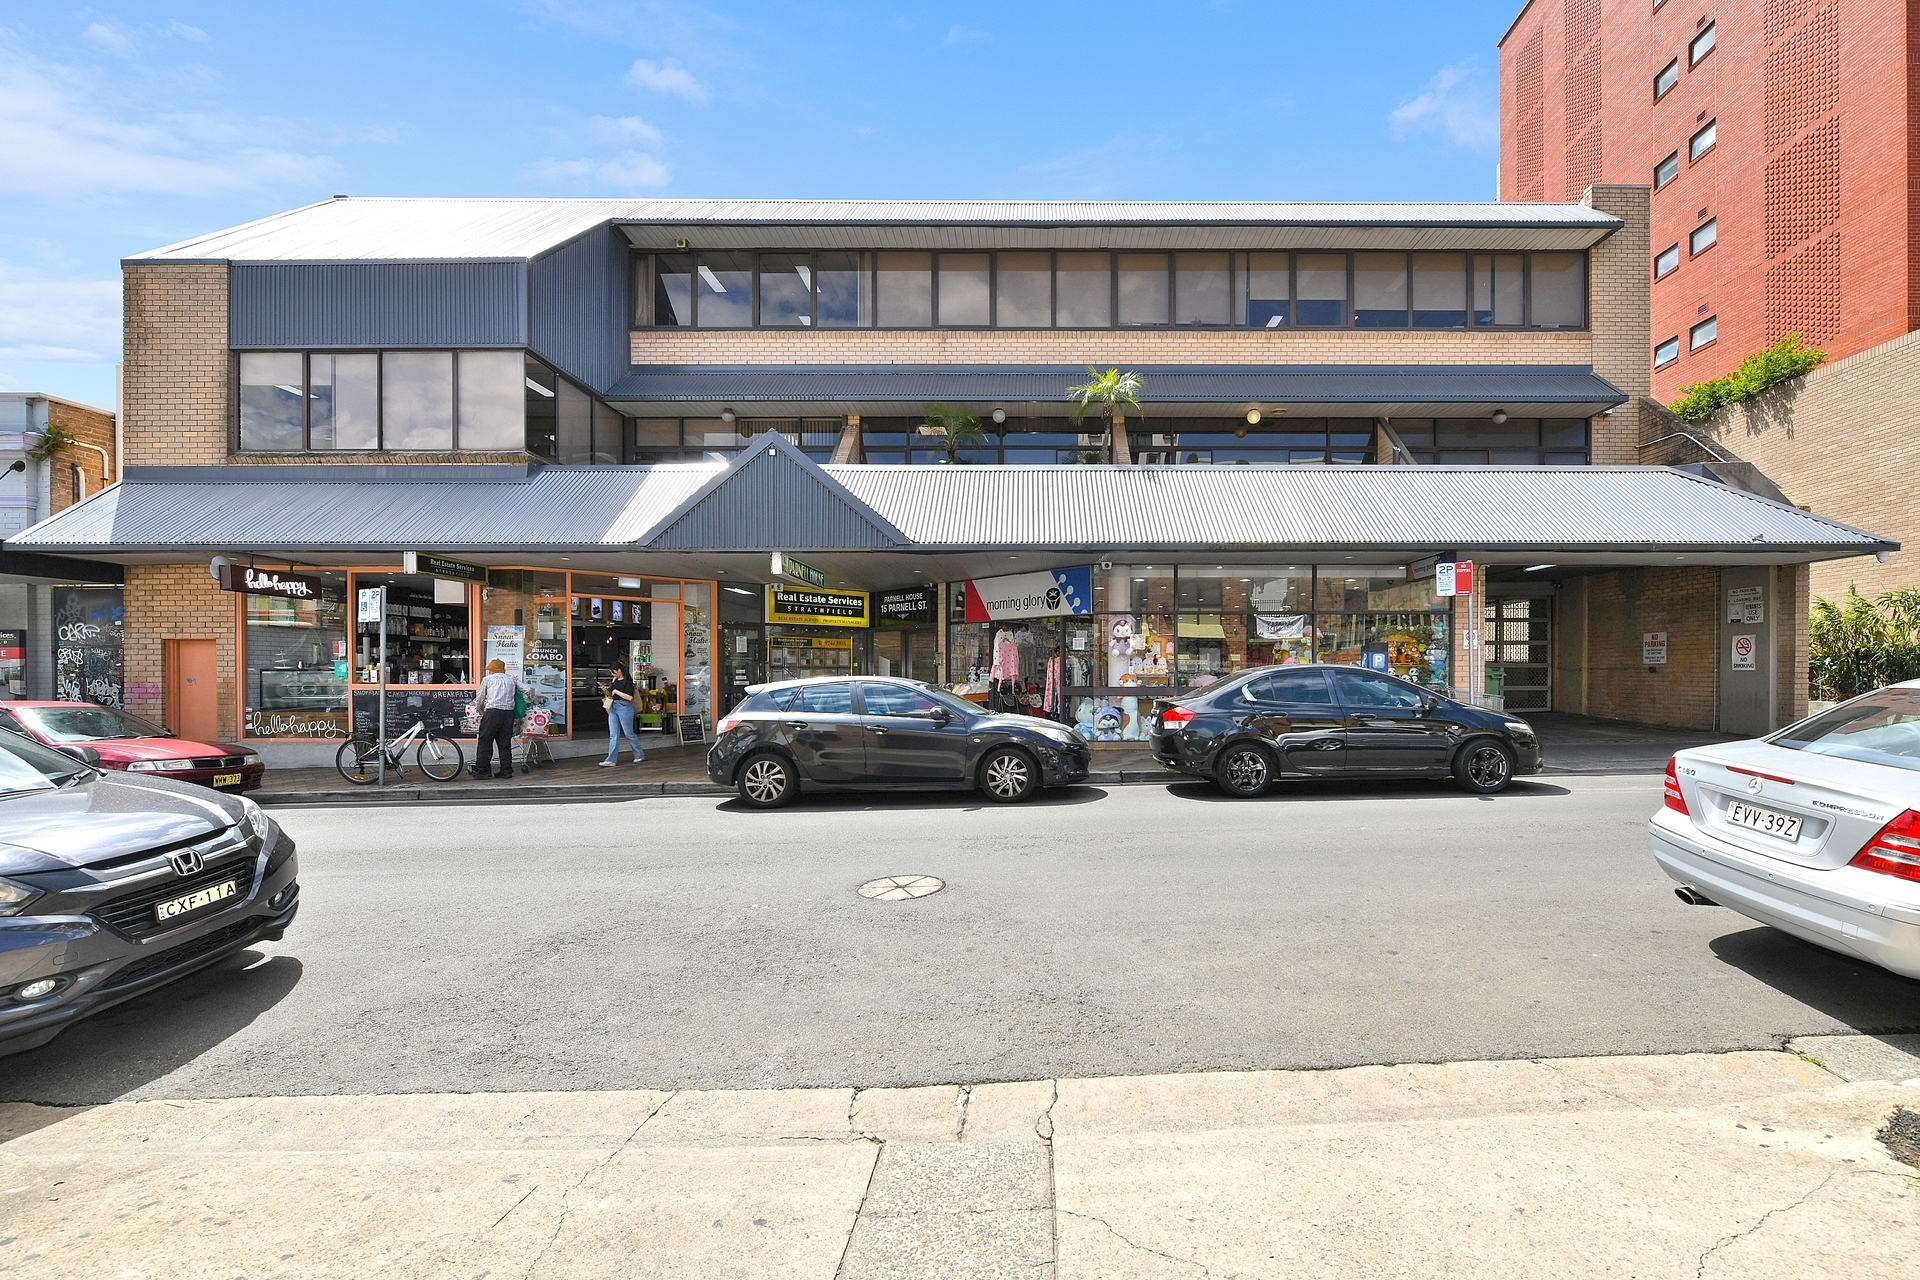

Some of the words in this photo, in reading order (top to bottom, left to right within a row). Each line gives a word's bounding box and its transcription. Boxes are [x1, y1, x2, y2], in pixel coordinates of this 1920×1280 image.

[430, 558, 441, 566] Real
[442, 560, 456, 568] Estate
[456, 564, 475, 572] Services
[371, 590, 380, 598] 2P
[778, 592, 797, 601] Real
[800, 594, 826, 604] Estate
[828, 596, 862, 606] Services
[884, 595, 905, 603] PARNELL
[905, 592, 923, 601] HOUSE
[881, 604, 887, 613] 15
[888, 602, 916, 612] PARNELL
[918, 601, 928, 610] ST.
[986, 596, 1021, 611] morning
[1023, 594, 1046, 610] glory
[788, 606, 853, 615] STRATHFIELD
[1375, 656, 1382, 666] P
[433, 691, 474, 699] BREAKFAST
[254, 712, 346, 738] hellohappy
